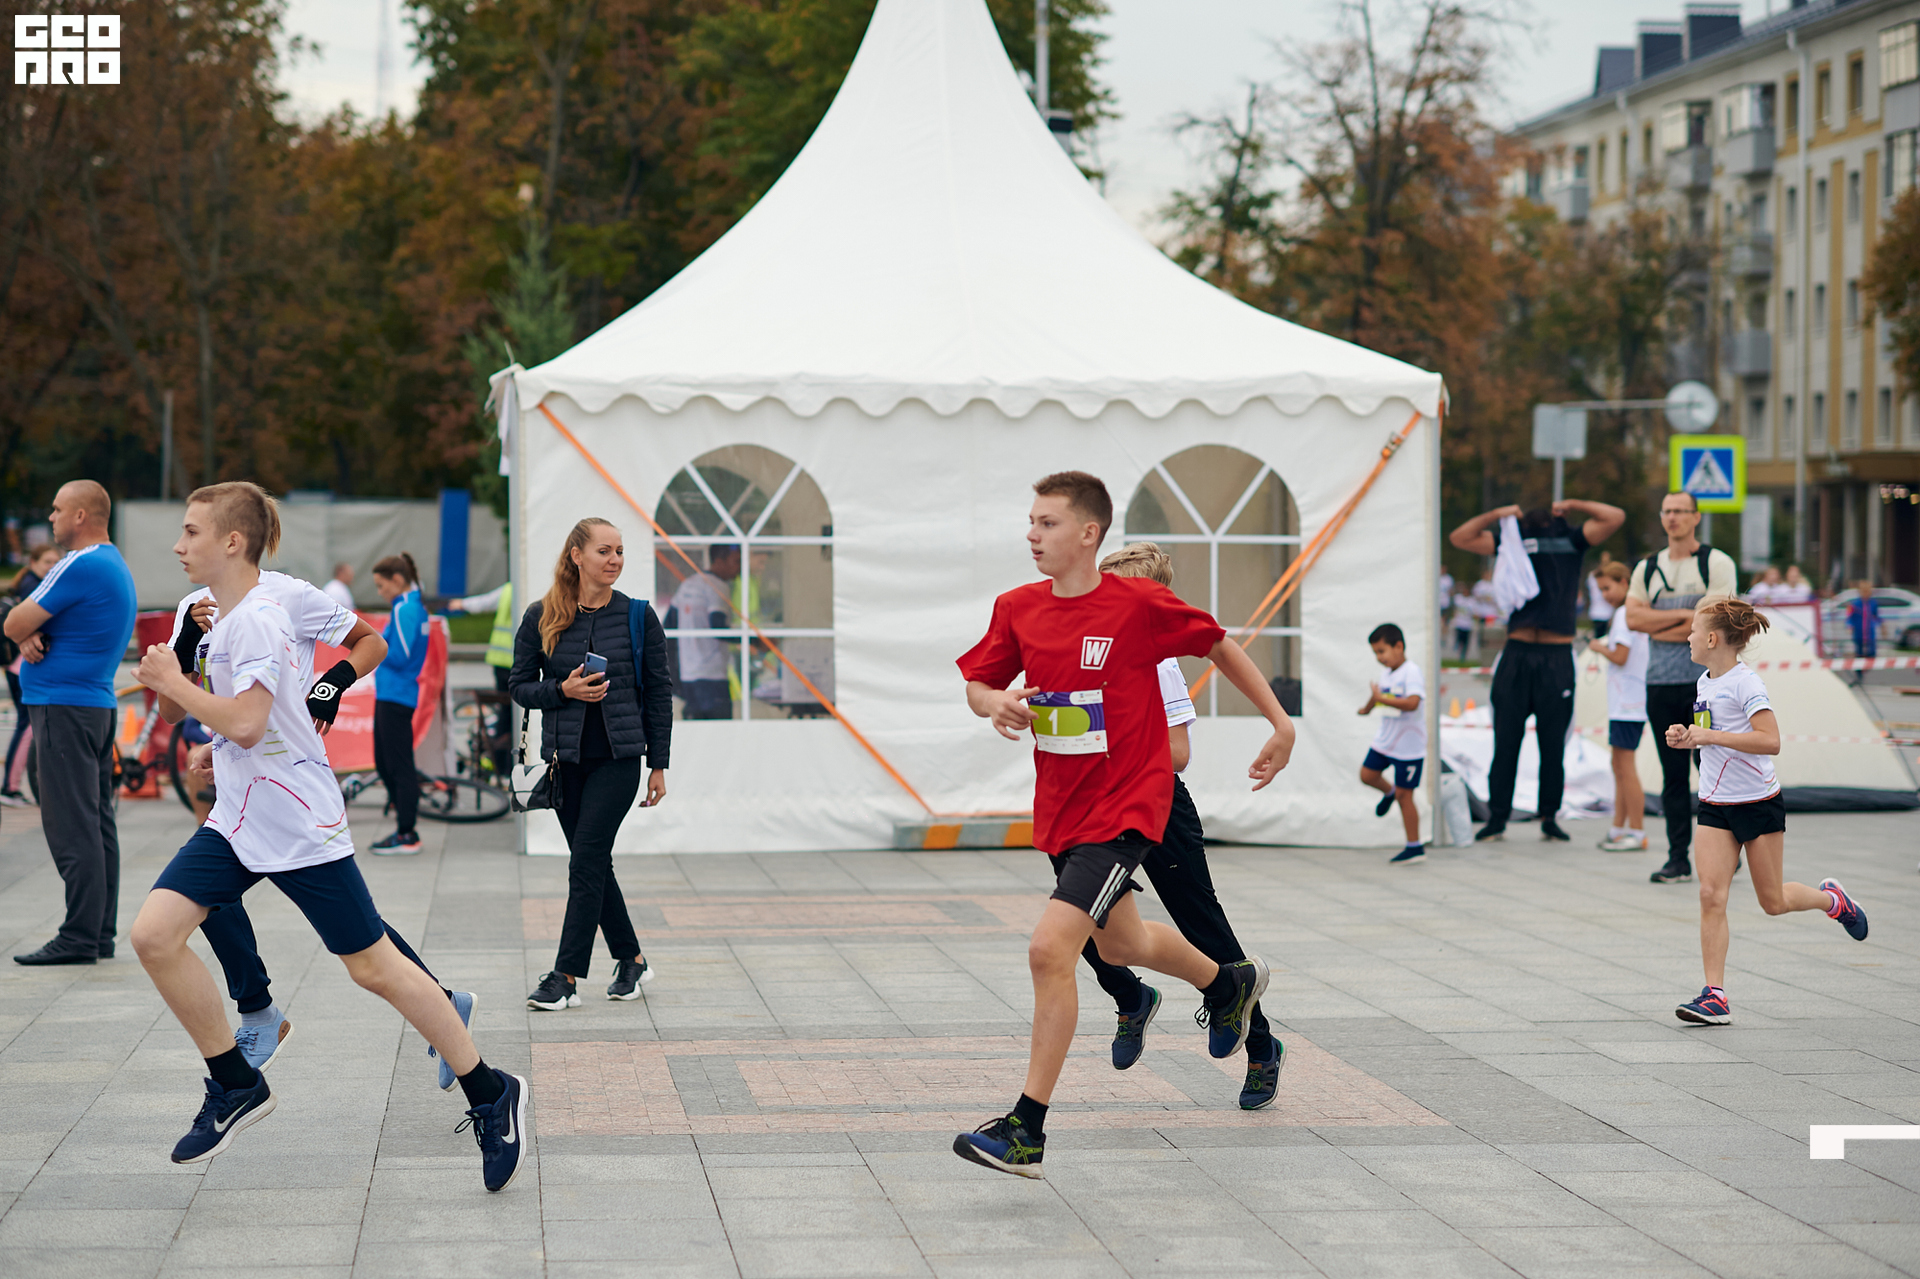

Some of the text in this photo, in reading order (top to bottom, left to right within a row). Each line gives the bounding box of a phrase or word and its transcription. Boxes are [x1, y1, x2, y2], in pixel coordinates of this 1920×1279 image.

[1084, 640, 1109, 667] W
[1048, 708, 1058, 735] 1
[1406, 765, 1417, 783] 7
